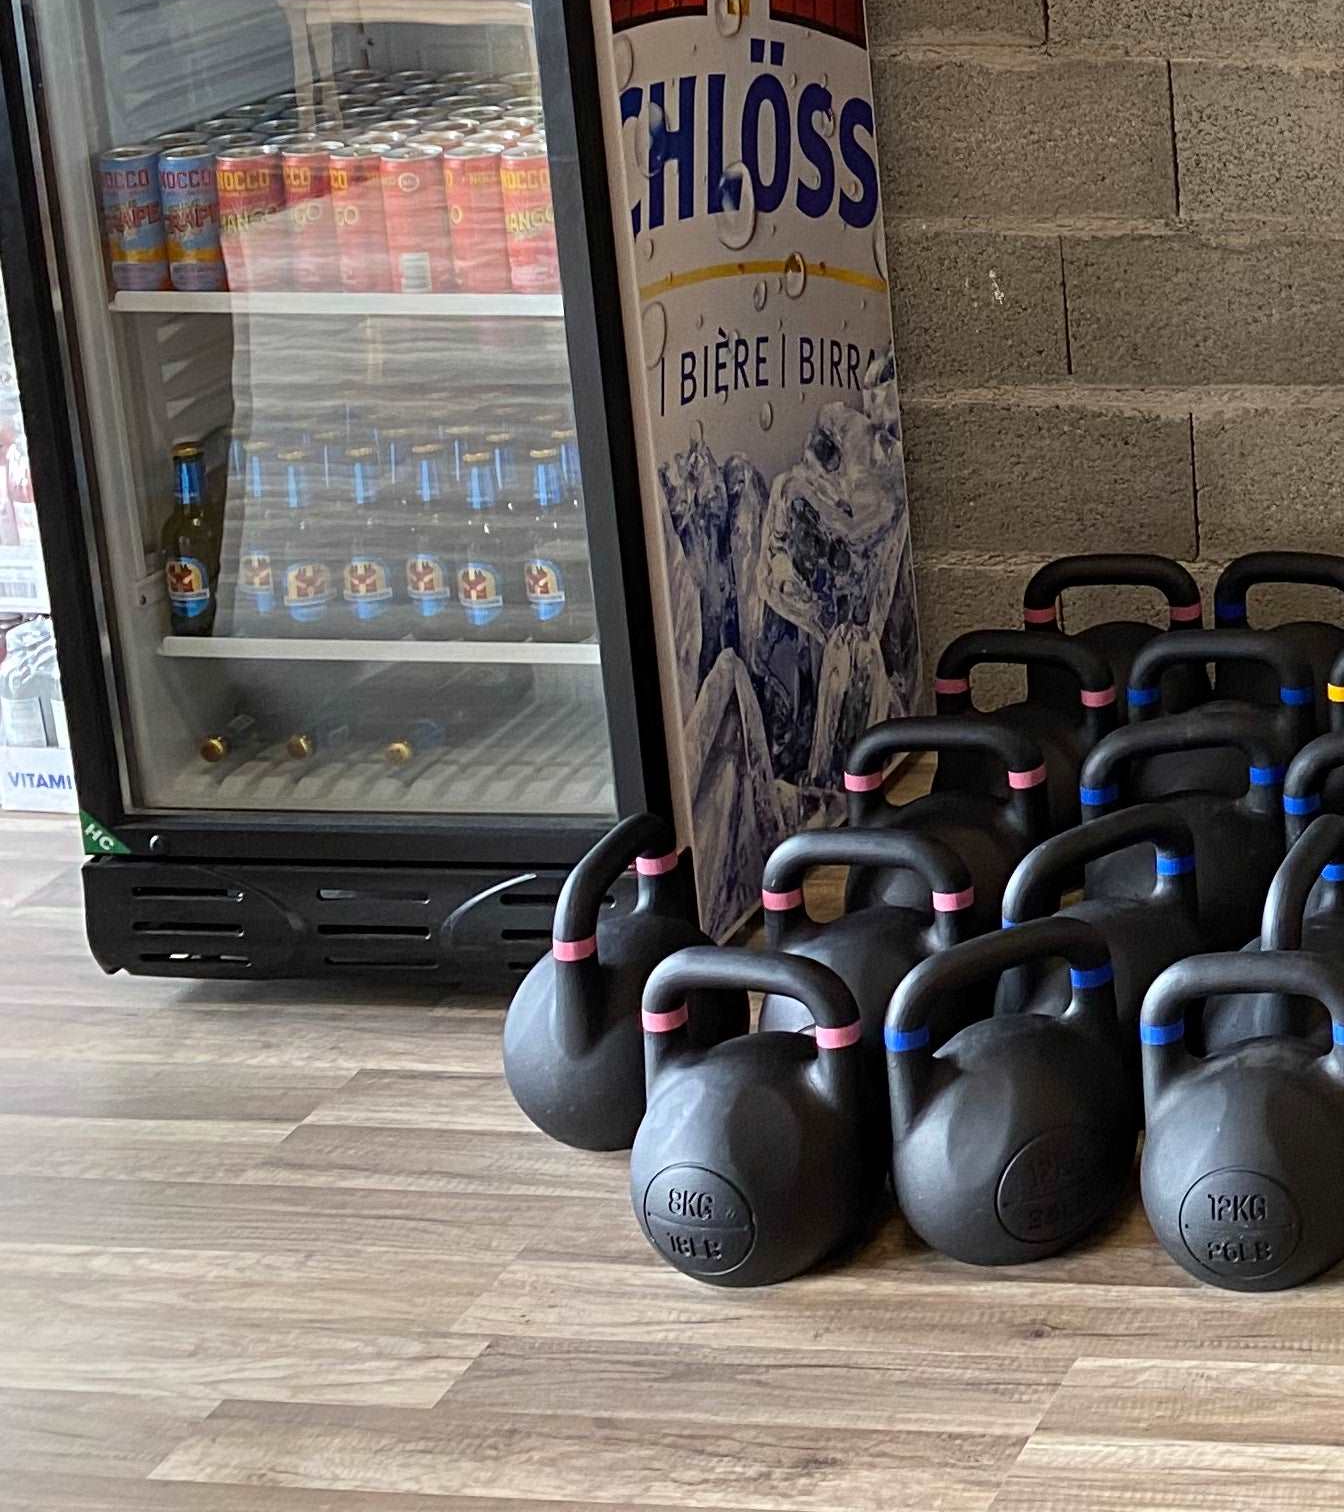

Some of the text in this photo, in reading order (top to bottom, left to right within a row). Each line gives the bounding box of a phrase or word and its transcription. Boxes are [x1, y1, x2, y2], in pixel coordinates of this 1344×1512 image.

[681, 327, 769, 406] BIÈRE
[8, 770, 72, 790] VITAMI
[84, 822, 114, 851] HC
[668, 1188, 713, 1221] 8KG
[1208, 1193, 1267, 1221] 12KG
